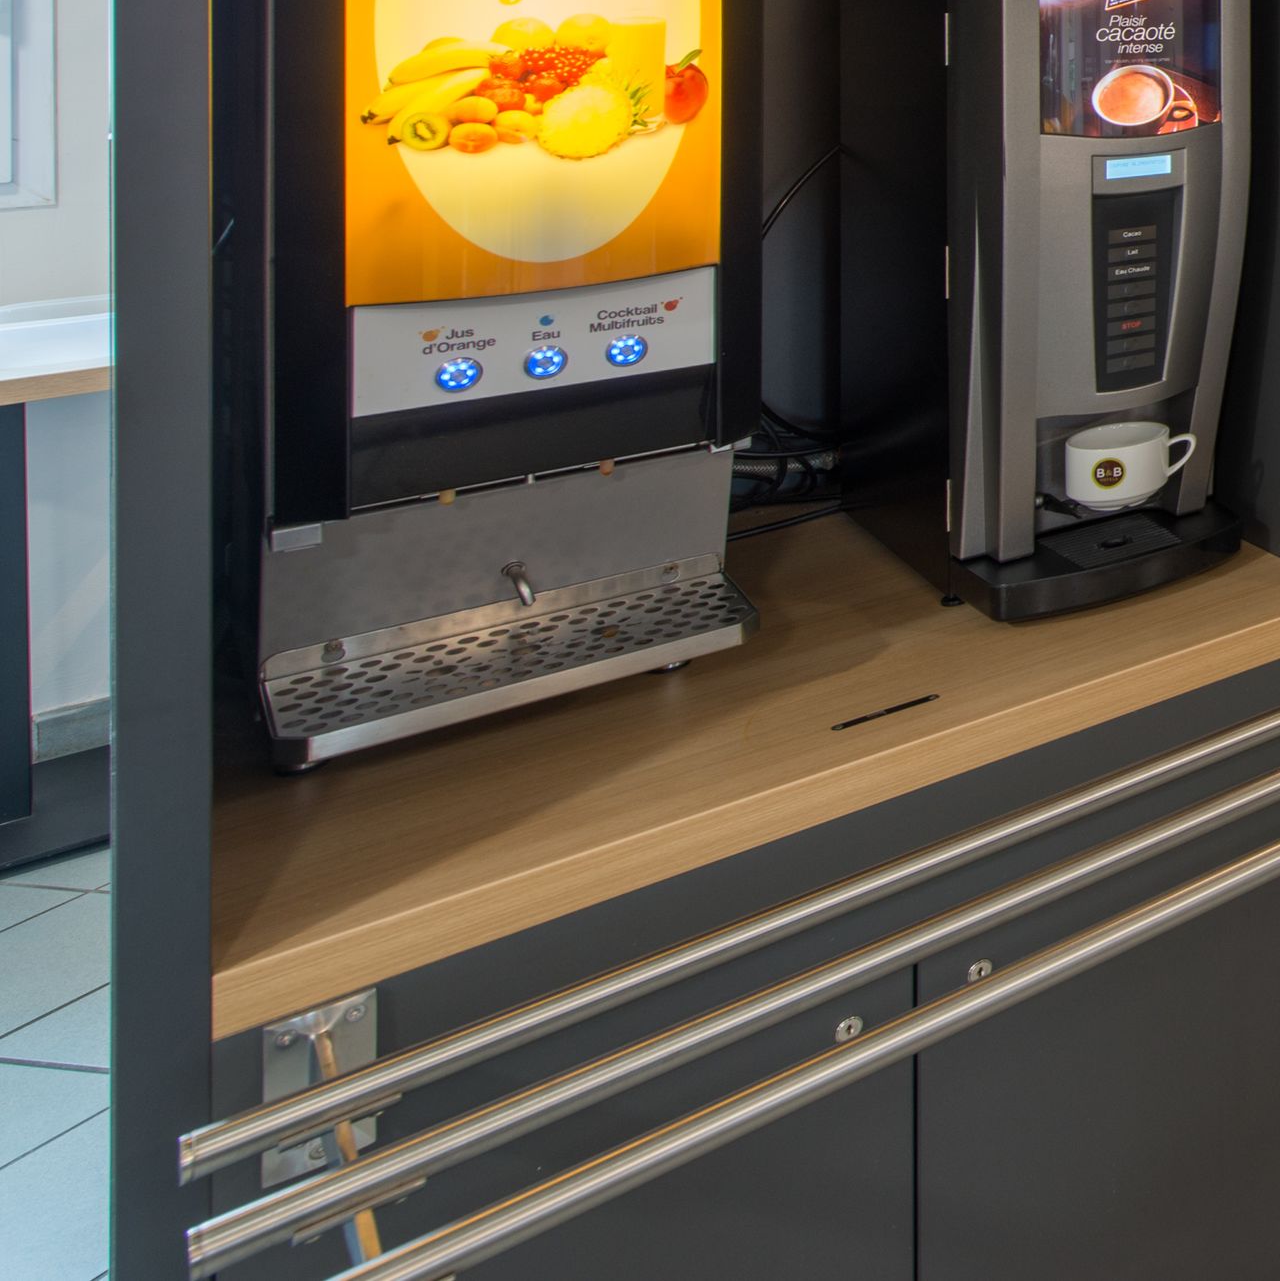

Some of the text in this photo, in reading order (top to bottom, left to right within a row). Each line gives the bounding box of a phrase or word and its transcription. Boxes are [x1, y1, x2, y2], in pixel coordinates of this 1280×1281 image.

[1109, 14, 1147, 27] Plaisir
[1096, 22, 1176, 42] cacaoté
[1117, 42, 1164, 54] intense
[1127, 265, 1150, 274] Chaude
[596, 304, 658, 321] Cocktail
[589, 315, 664, 334] Multifruits
[1121, 320, 1143, 330] STOP
[445, 327, 475, 340] Jus
[531, 329, 561, 342] Eau
[422, 336, 497, 356] d'Orange
